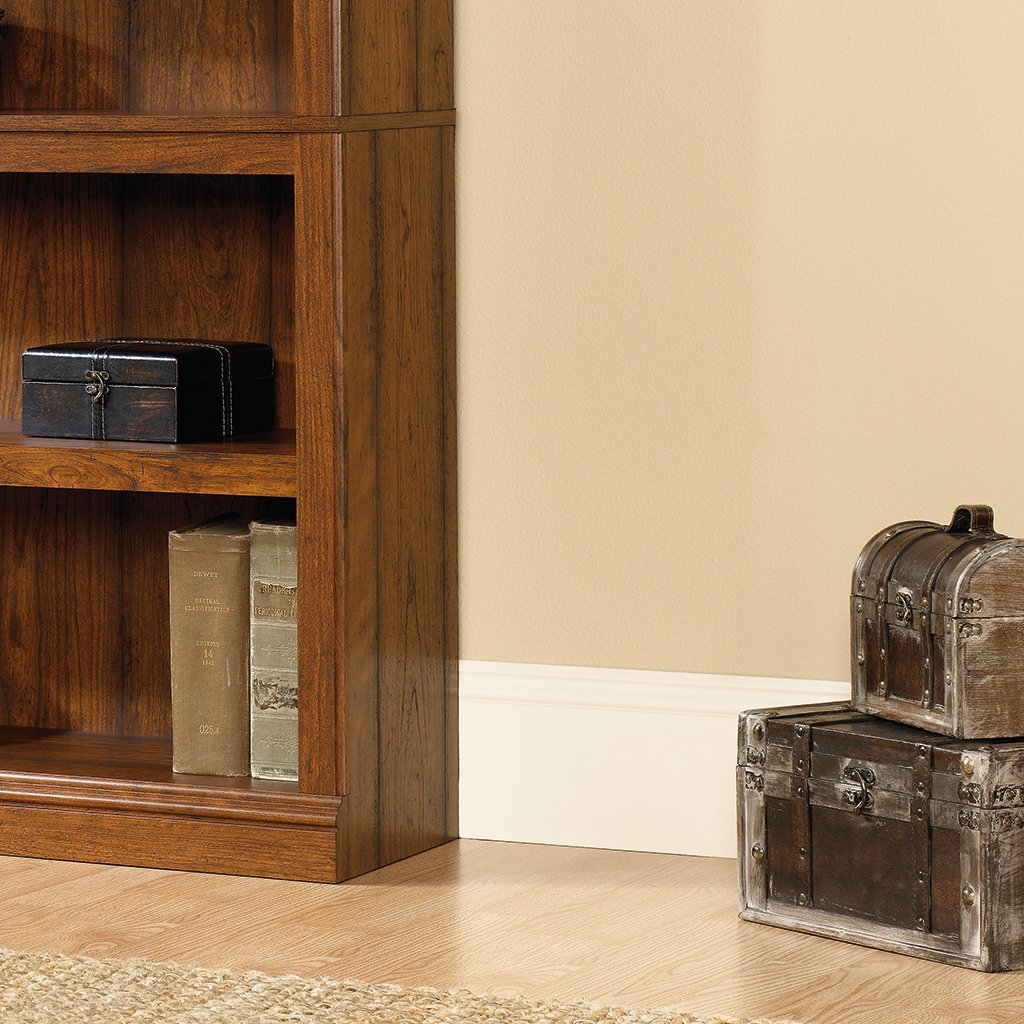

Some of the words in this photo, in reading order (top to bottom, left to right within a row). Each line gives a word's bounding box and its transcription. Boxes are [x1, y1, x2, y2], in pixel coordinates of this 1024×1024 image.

[193, 570, 219, 579] DEWEY
[194, 597, 221, 606] DECIMAL
[184, 605, 232, 614] CLASSIFICATION
